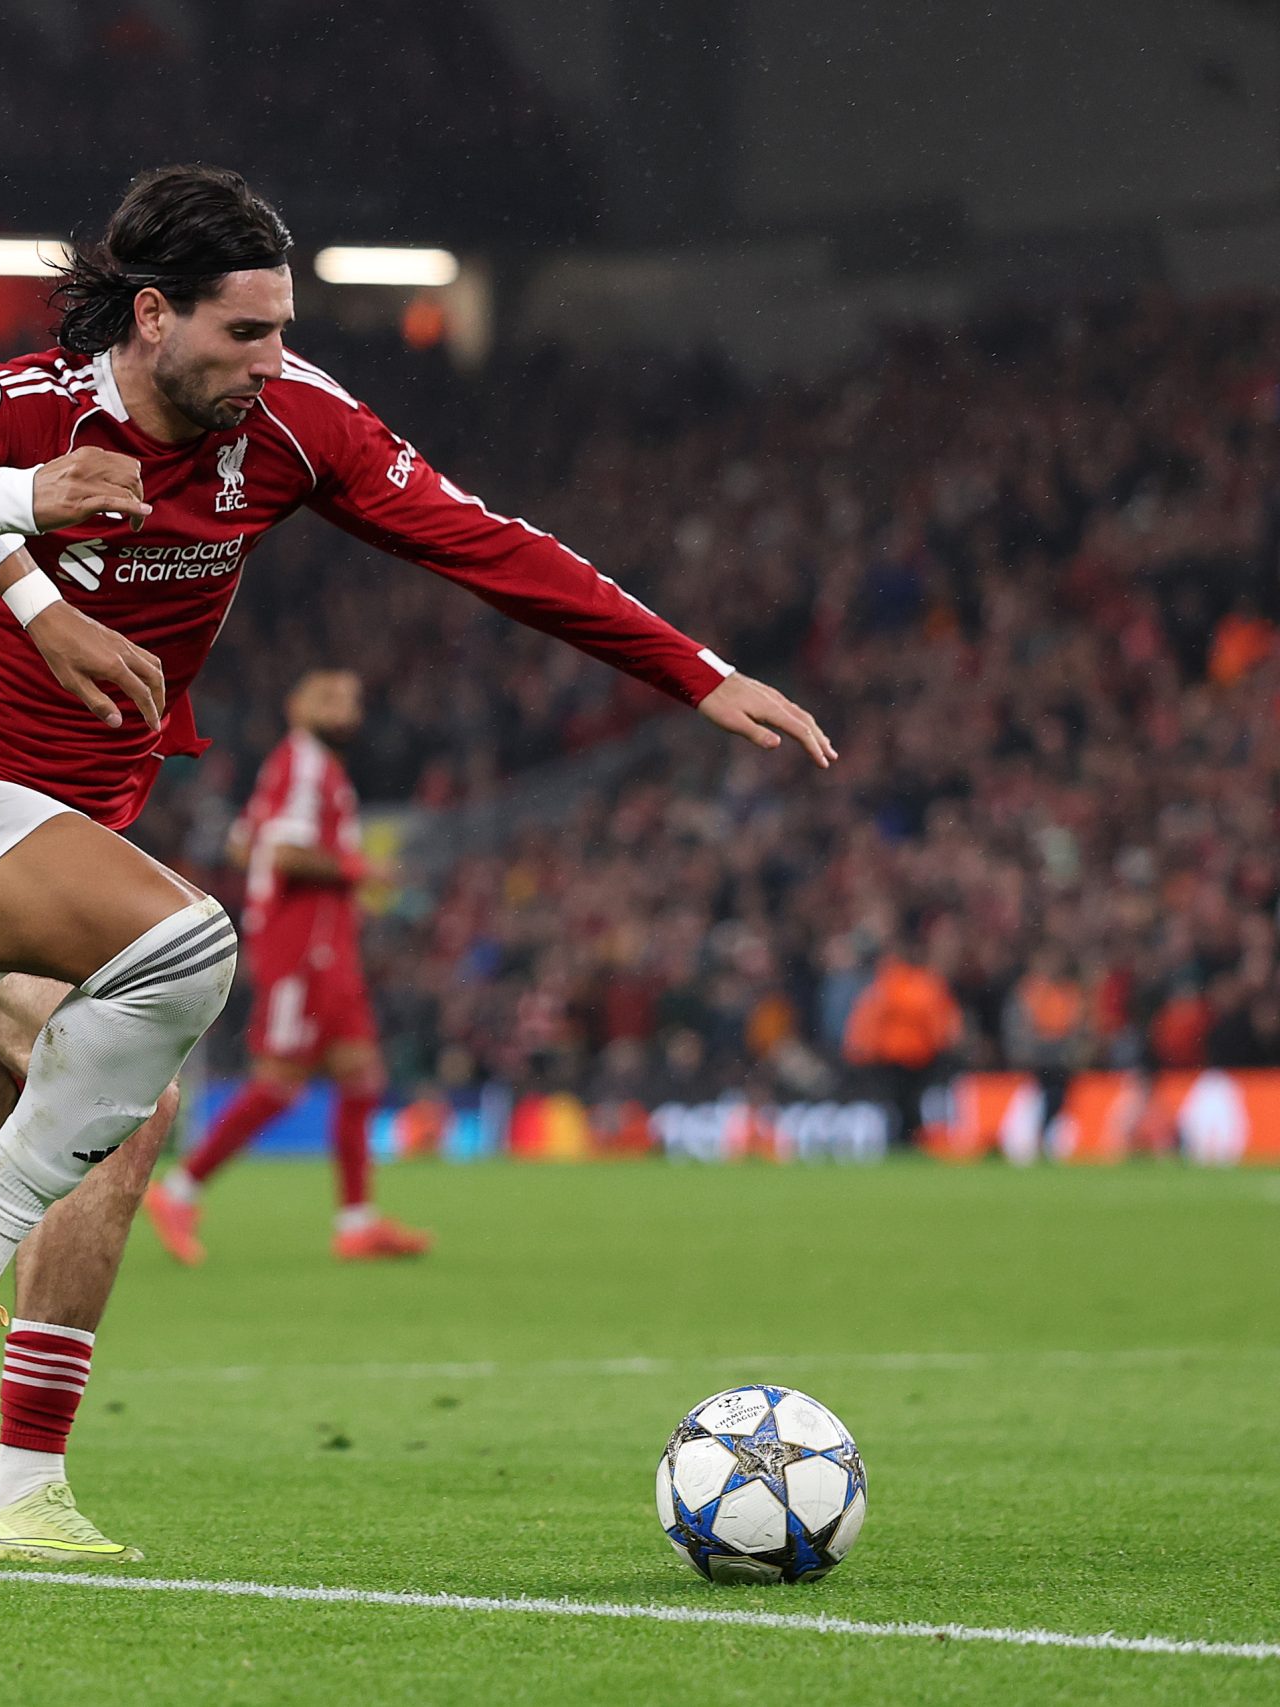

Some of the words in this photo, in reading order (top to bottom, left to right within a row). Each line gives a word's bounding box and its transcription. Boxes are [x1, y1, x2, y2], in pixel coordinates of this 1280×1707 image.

[118, 532, 244, 561] standard
[114, 550, 243, 583] chartered
[714, 1404, 766, 1429] CHAMPIONS
[725, 1410, 759, 1429] LEAGUE
